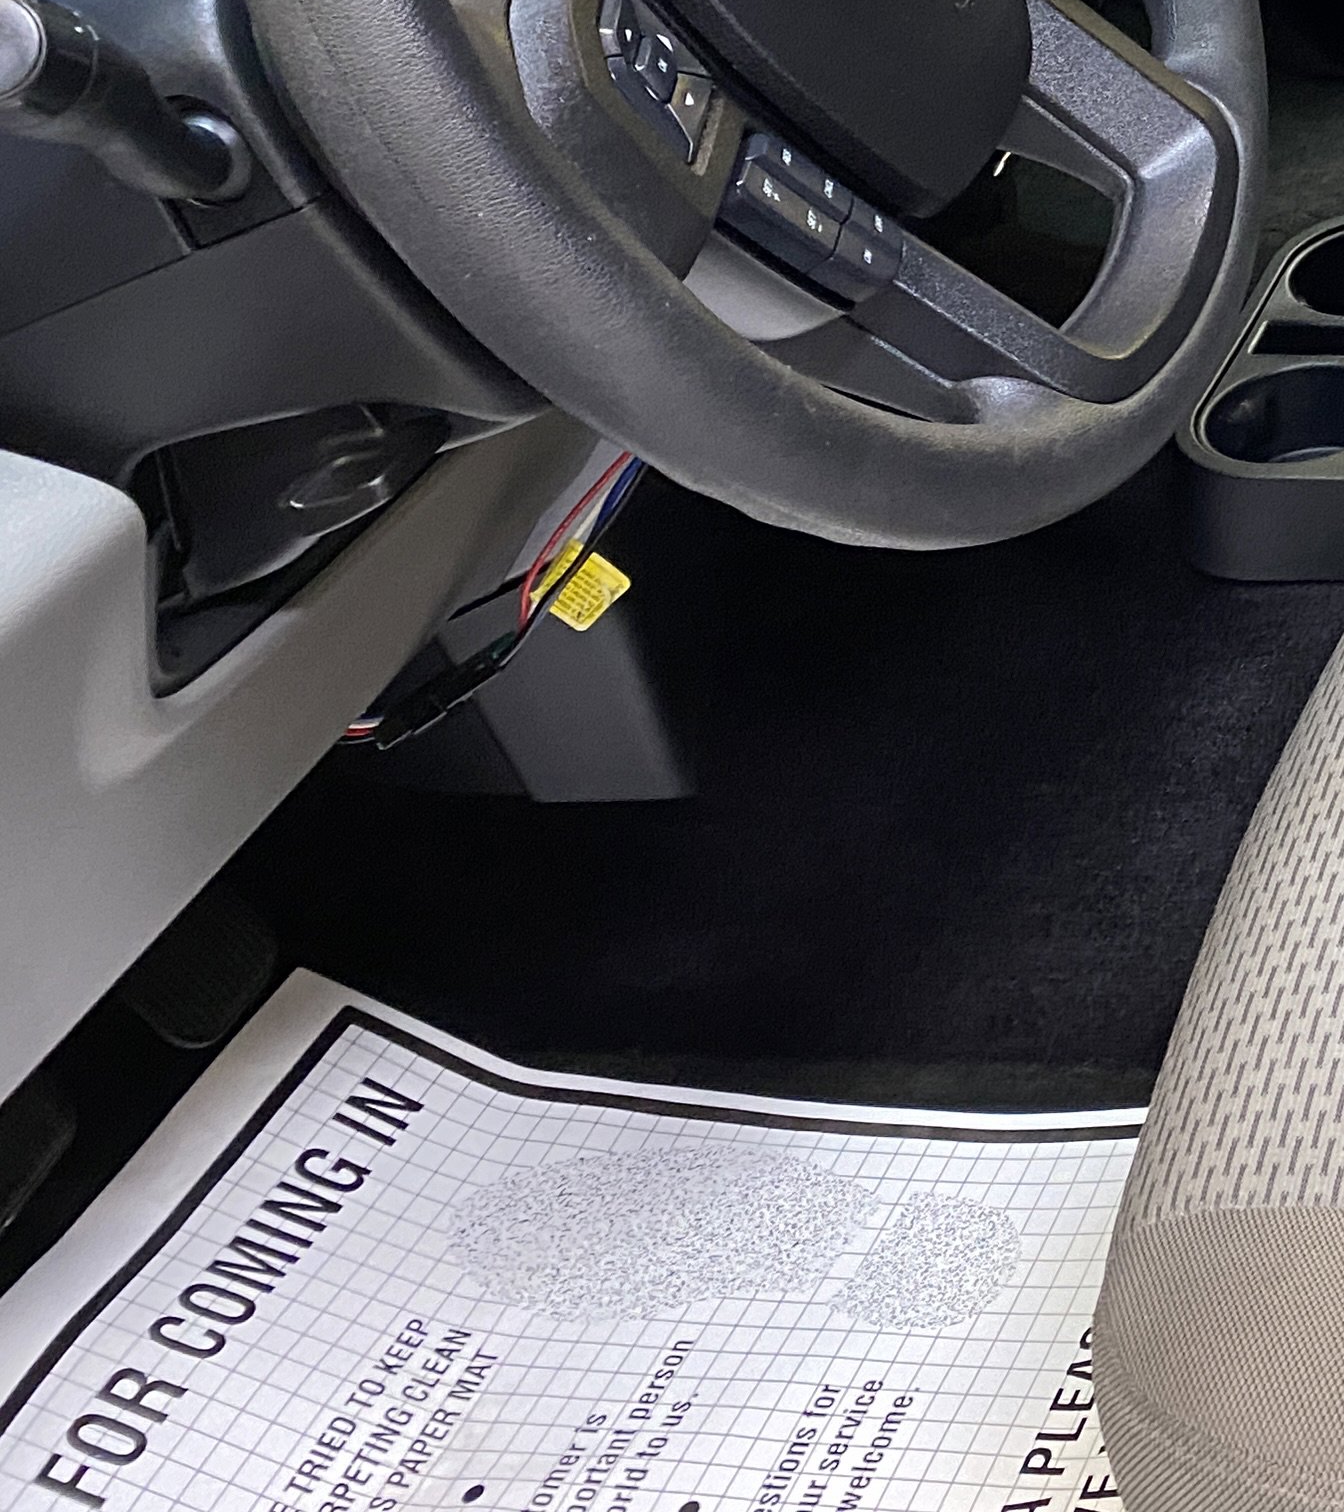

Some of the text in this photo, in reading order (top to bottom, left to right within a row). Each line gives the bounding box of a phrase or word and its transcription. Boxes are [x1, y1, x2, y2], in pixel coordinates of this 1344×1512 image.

[33, 1077, 424, 1509] FOR COMING IN
[402, 1329, 473, 1402] CLEAN
[628, 1340, 695, 1420] person
[802, 1384, 841, 1418] for
[283, 1417, 357, 1493] TRIED
[344, 1379, 386, 1408] TO
[373, 1319, 429, 1375] KEEP
[387, 1408, 462, 1489] PAPER
[449, 1348, 499, 1401] MAT
[574, 1414, 608, 1433] is
[636, 1438, 669, 1458] to
[660, 1393, 699, 1427] us.
[797, 1380, 884, 1512] ur service
